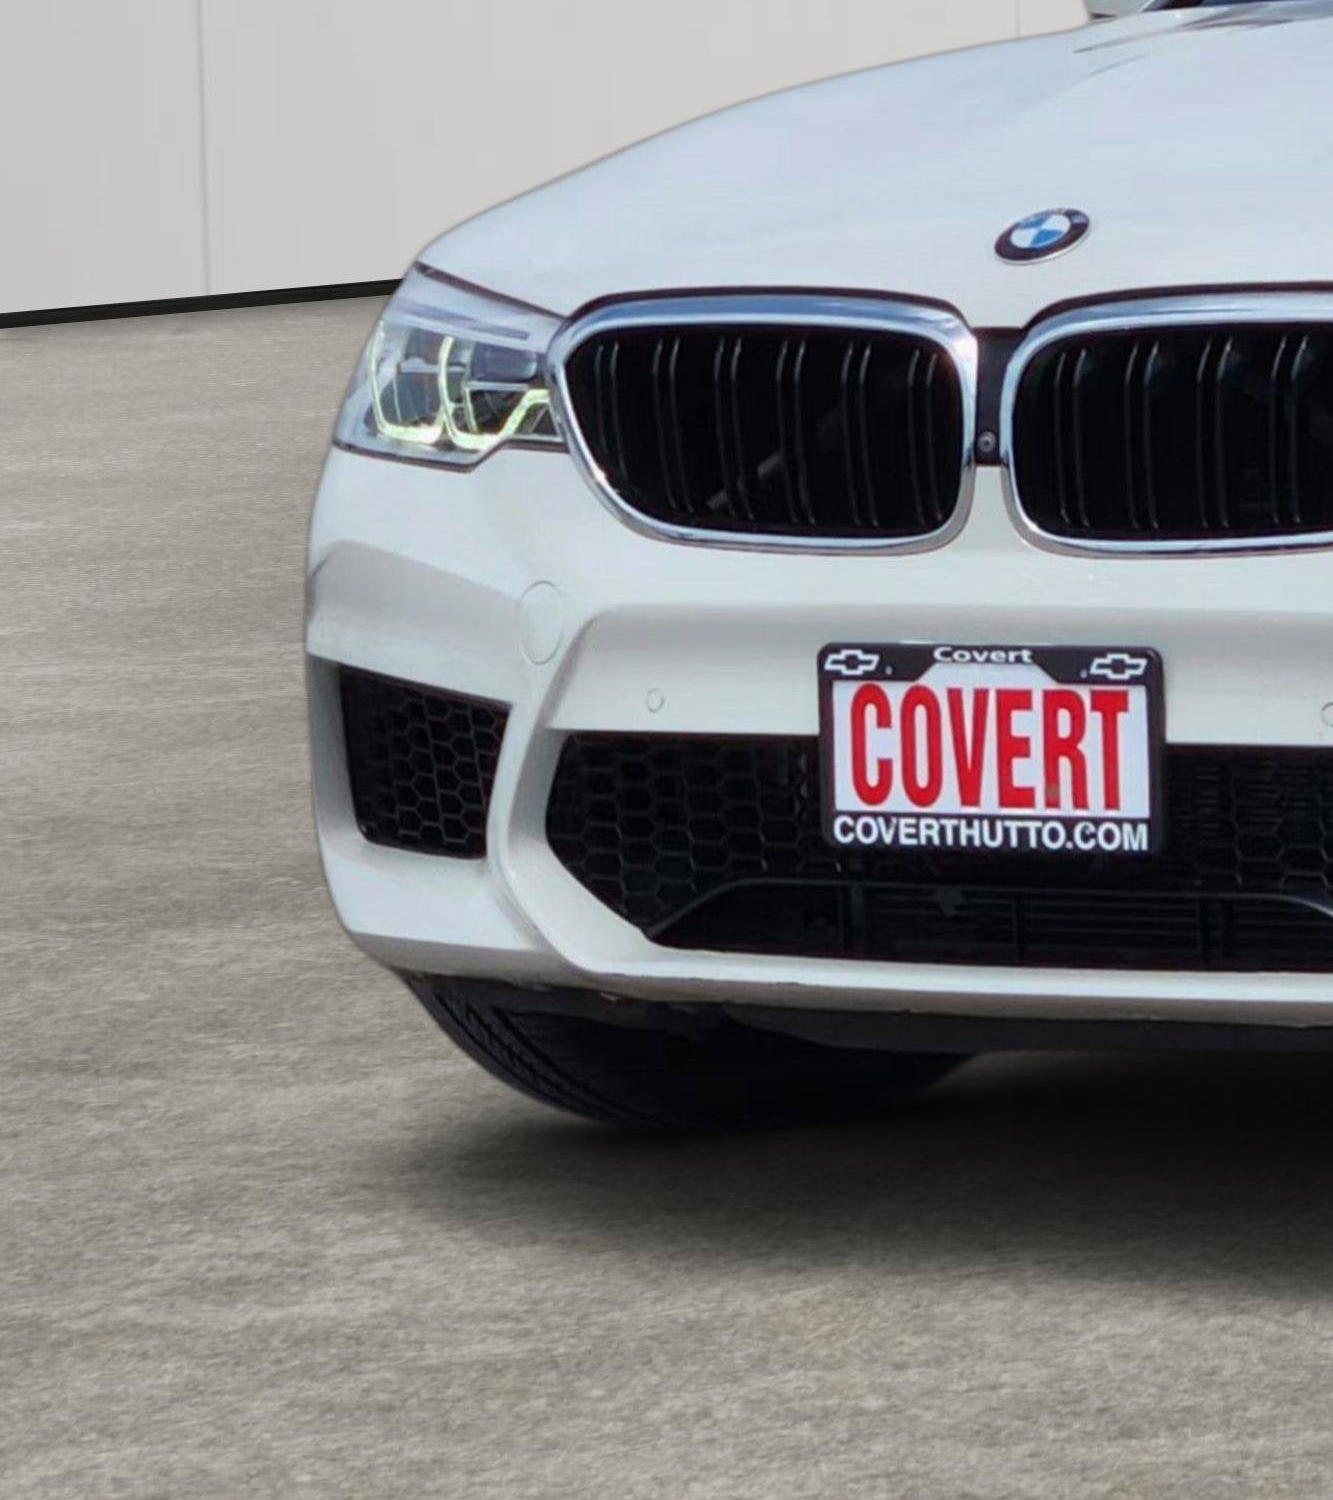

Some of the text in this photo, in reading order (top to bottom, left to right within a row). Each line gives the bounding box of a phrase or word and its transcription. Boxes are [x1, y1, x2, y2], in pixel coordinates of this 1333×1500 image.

[933, 646, 1033, 664] Covert
[850, 682, 1129, 812] COVERT
[833, 815, 1149, 851] COVERTHUTTO.COM
